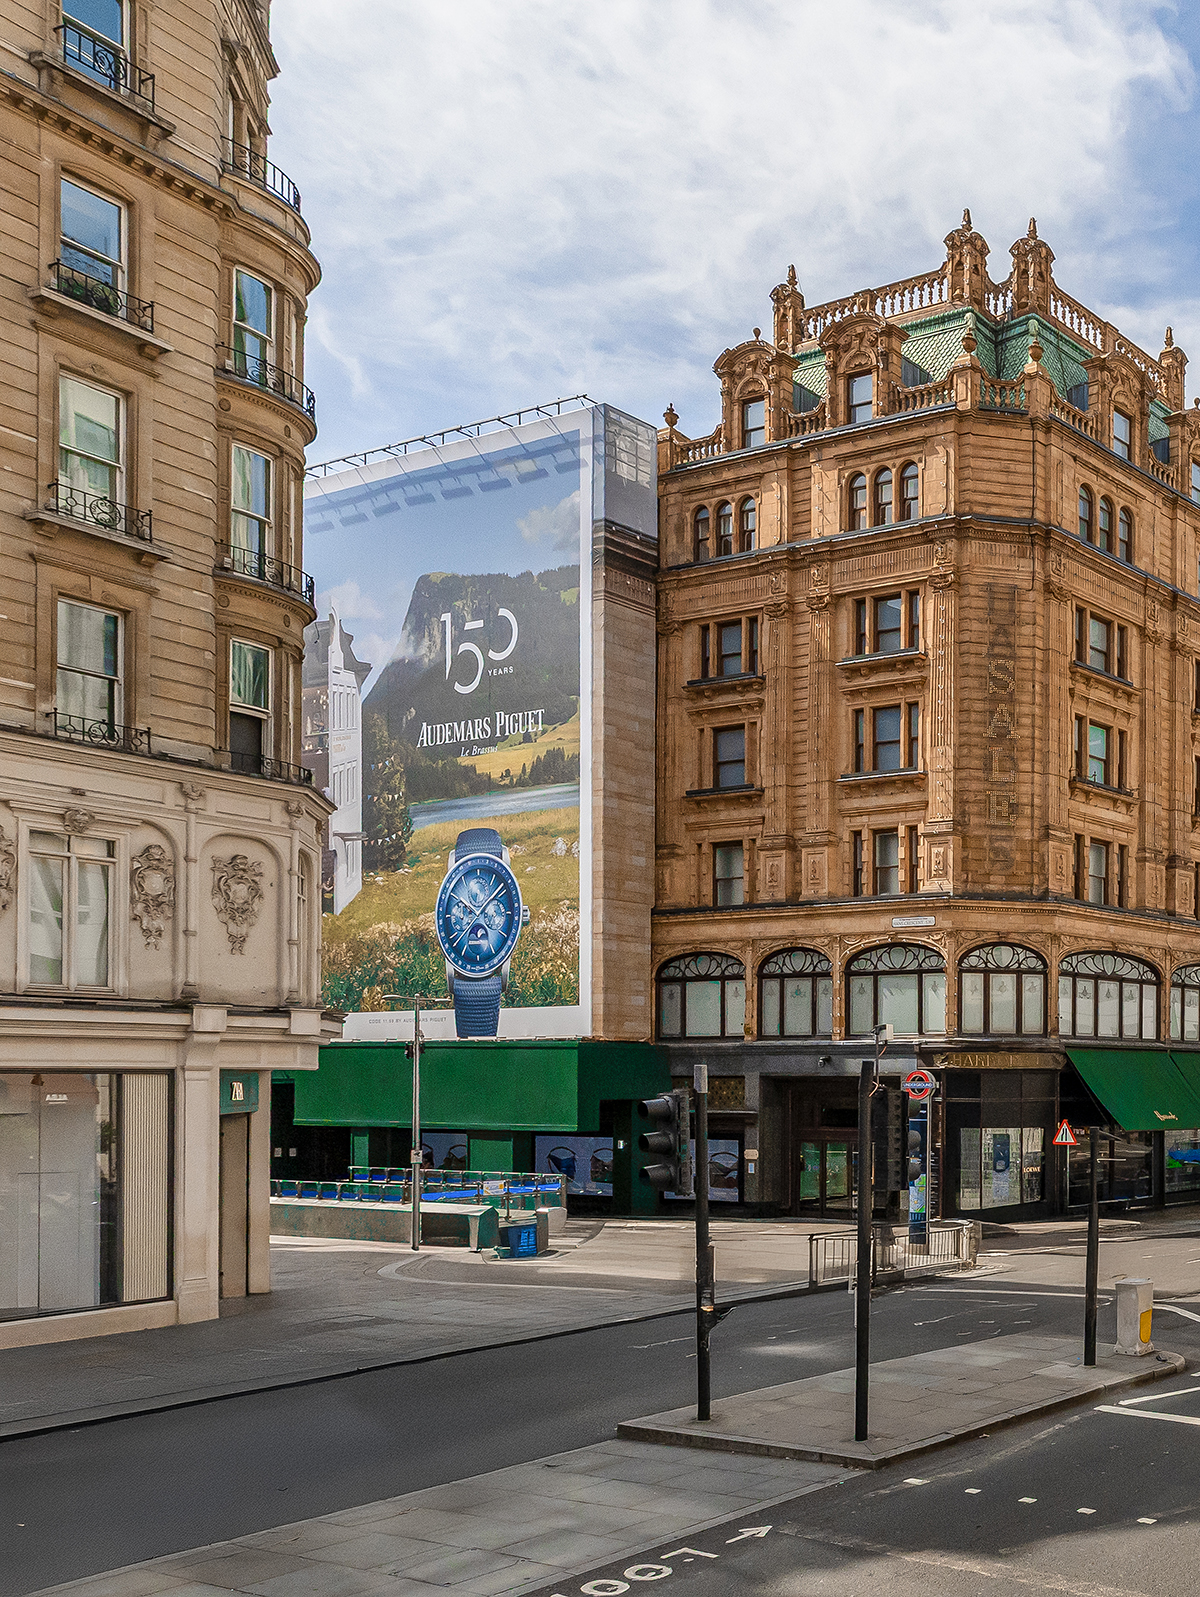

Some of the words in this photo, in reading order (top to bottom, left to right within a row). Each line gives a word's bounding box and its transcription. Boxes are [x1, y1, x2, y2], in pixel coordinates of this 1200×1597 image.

[439, 607, 519, 695] 150
[487, 666, 514, 677] YEARS
[417, 716, 492, 748] AUDEMARS
[495, 708, 545, 738] PIGUET
[460, 745, 470, 757] Le
[472, 744, 499, 757] Brassus
